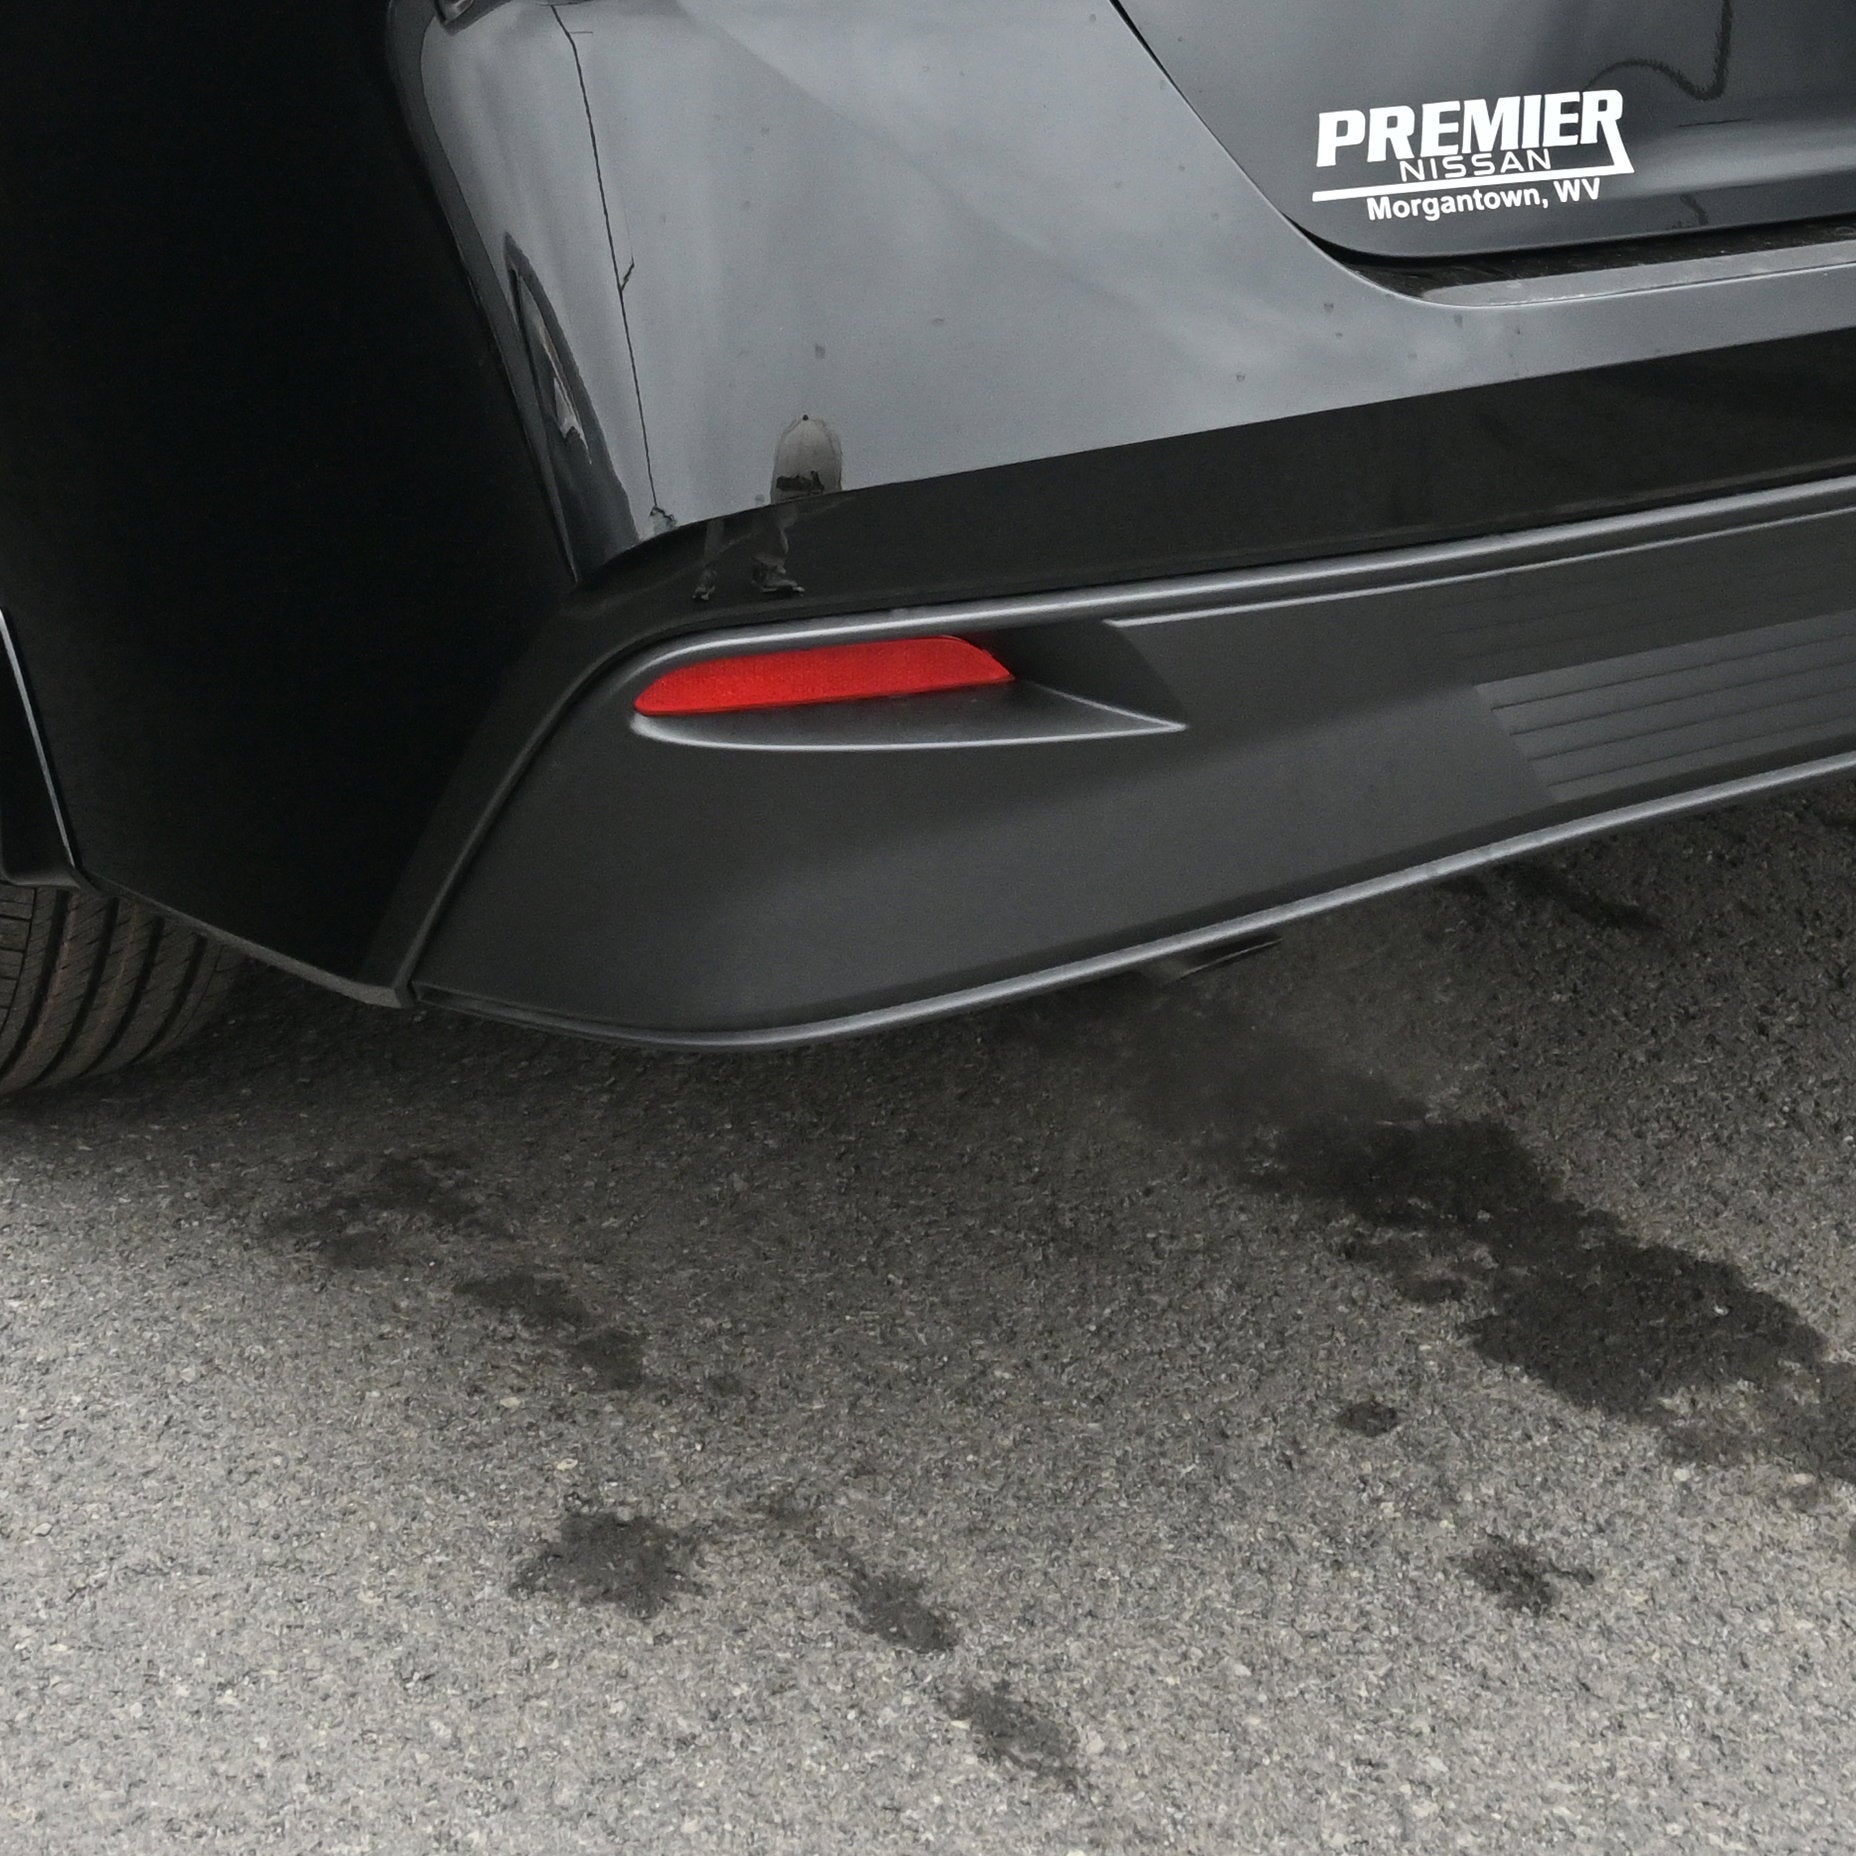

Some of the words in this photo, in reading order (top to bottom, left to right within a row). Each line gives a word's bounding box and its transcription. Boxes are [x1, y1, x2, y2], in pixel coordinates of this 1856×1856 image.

[1316, 89, 1635, 173] PREMIER
[1399, 147, 1552, 182] NISSAN
[1366, 184, 1550, 222] Morgantown,
[1552, 177, 1602, 203] WV
